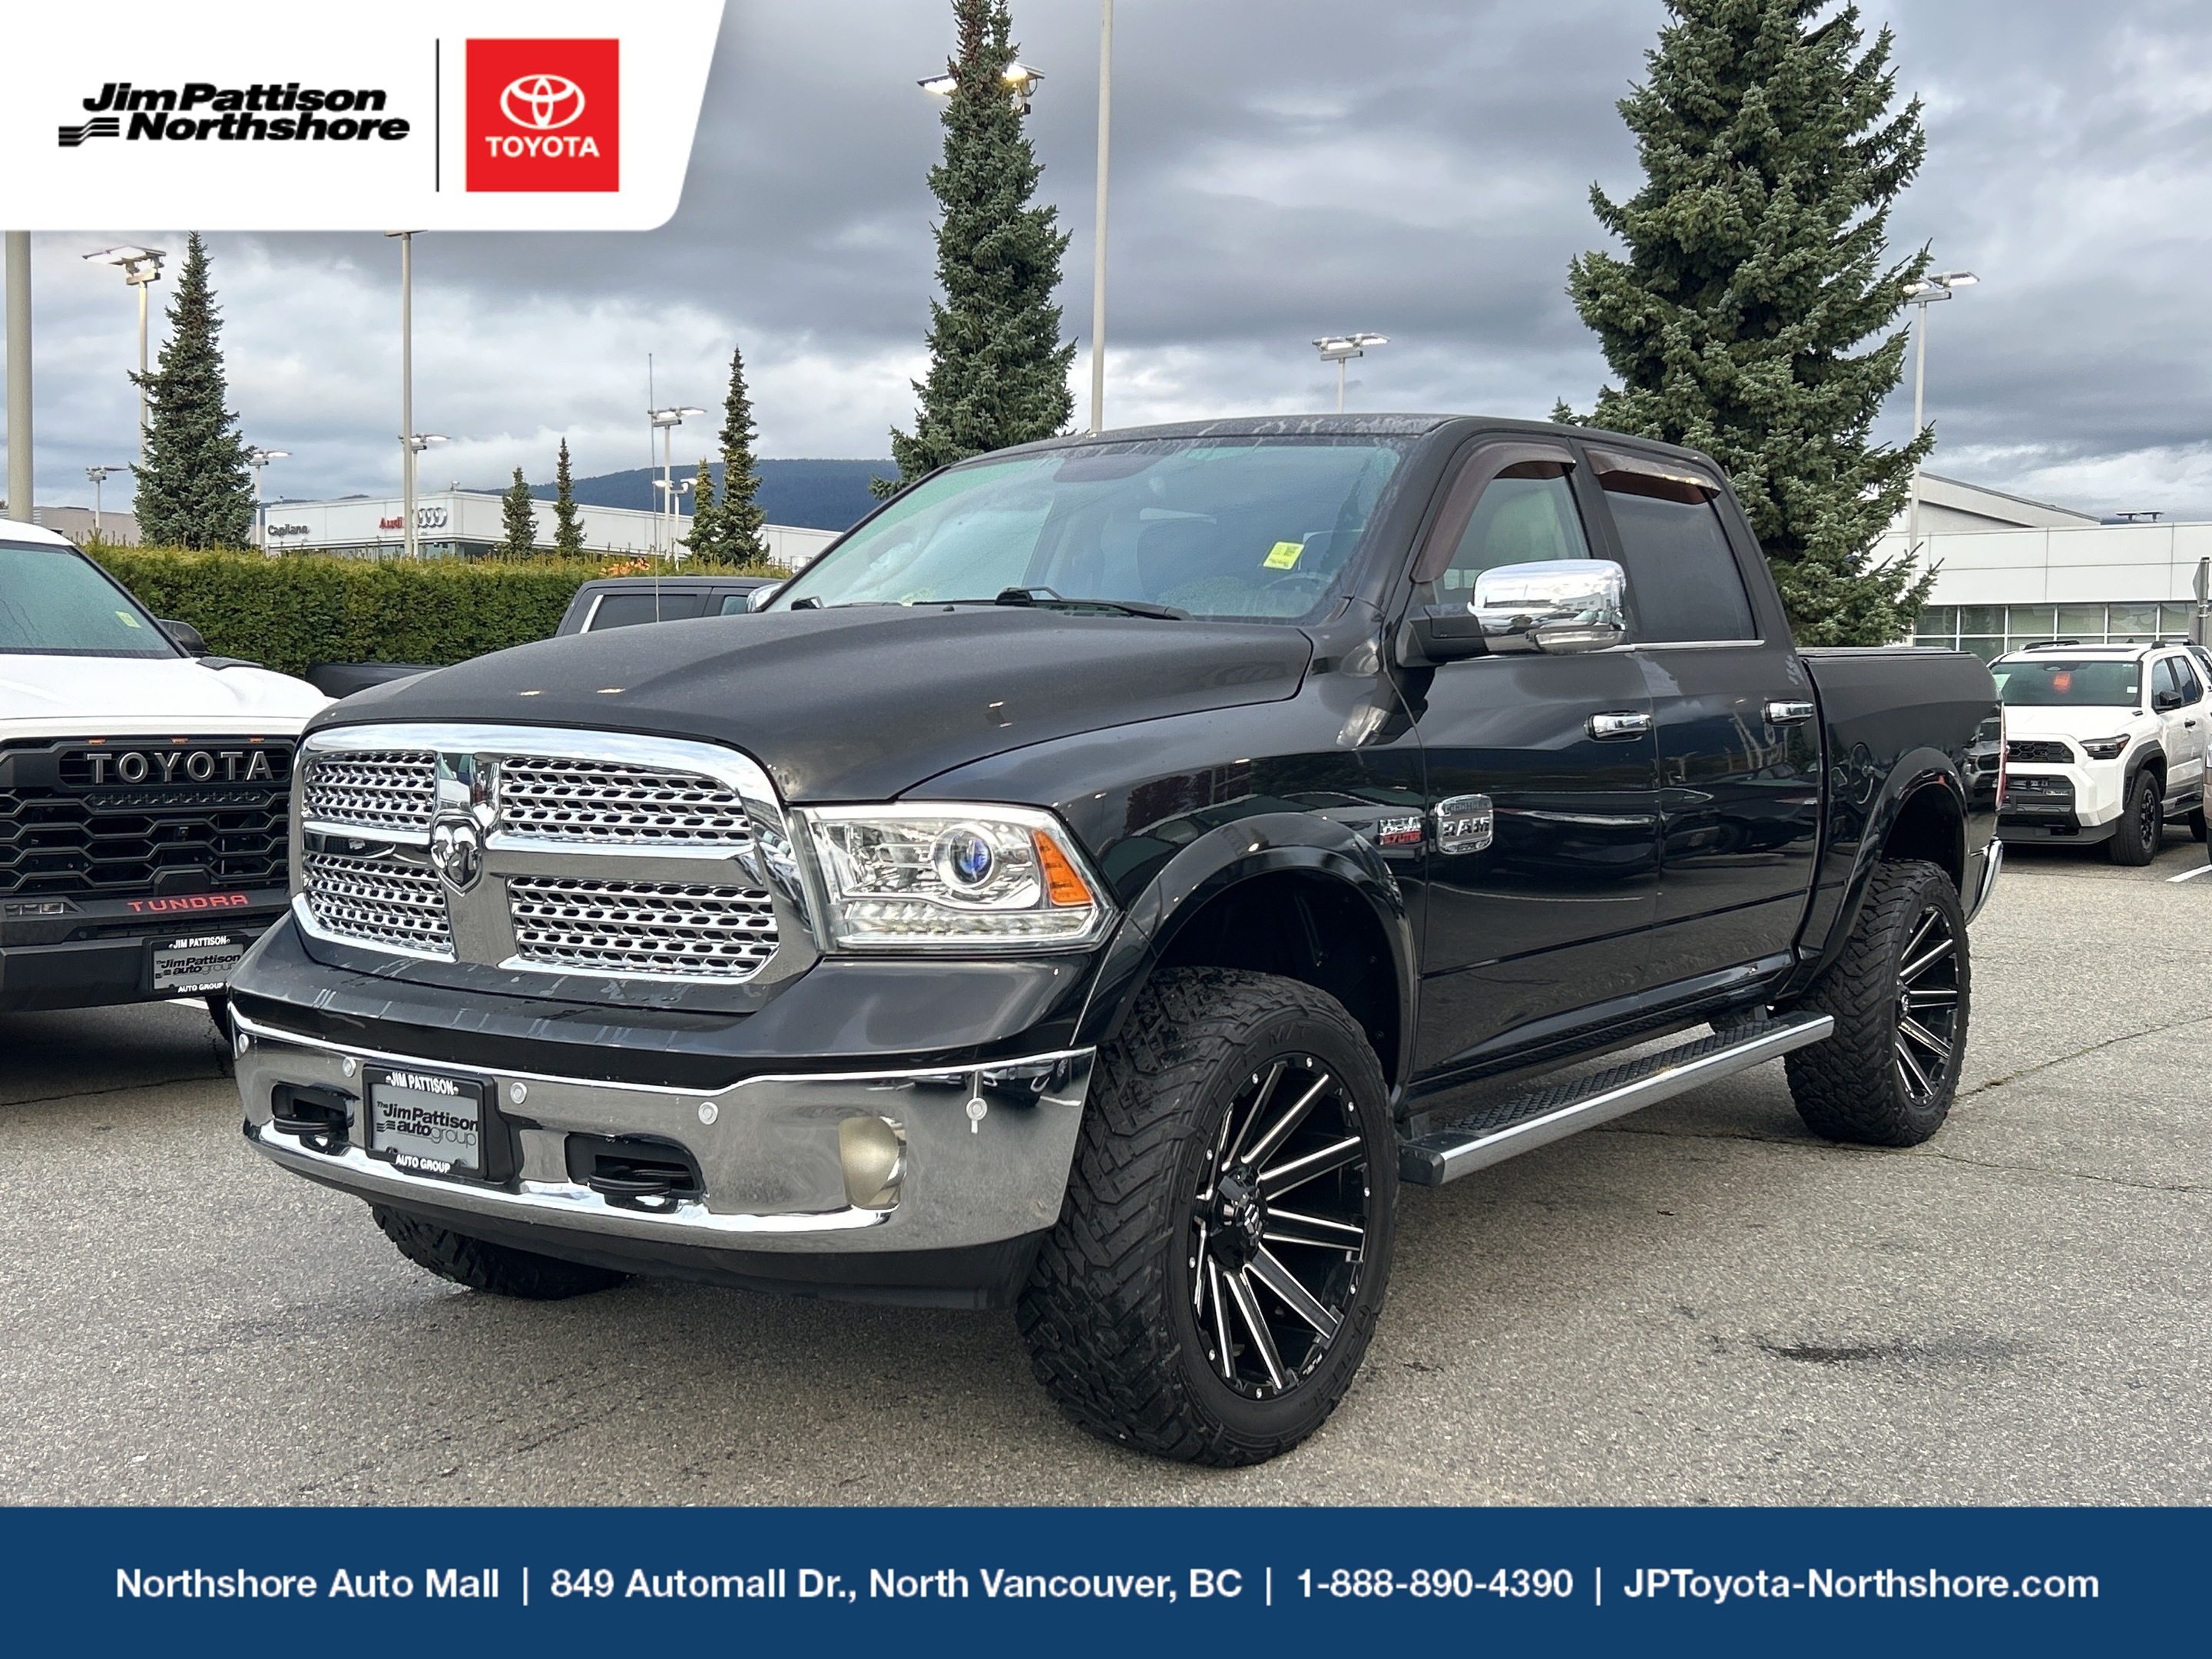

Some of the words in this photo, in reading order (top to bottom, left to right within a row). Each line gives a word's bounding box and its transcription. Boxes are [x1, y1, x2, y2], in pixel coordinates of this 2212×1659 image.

[379, 516, 402, 529] Audi
[268, 524, 310, 537] Capilano
[86, 750, 274, 784] TOYOTA
[127, 894, 250, 913] TUNDRA
[174, 939, 187, 949] JIM
[188, 935, 227, 949] PATTISON
[177, 985, 198, 994] AUTO
[198, 982, 225, 992] GROUP
[390, 1071, 409, 1088] JIM
[408, 1074, 455, 1096] PATTISON
[376, 1101, 389, 1109] The
[396, 1154, 419, 1168] AUTO
[419, 1157, 452, 1174] GROUP
